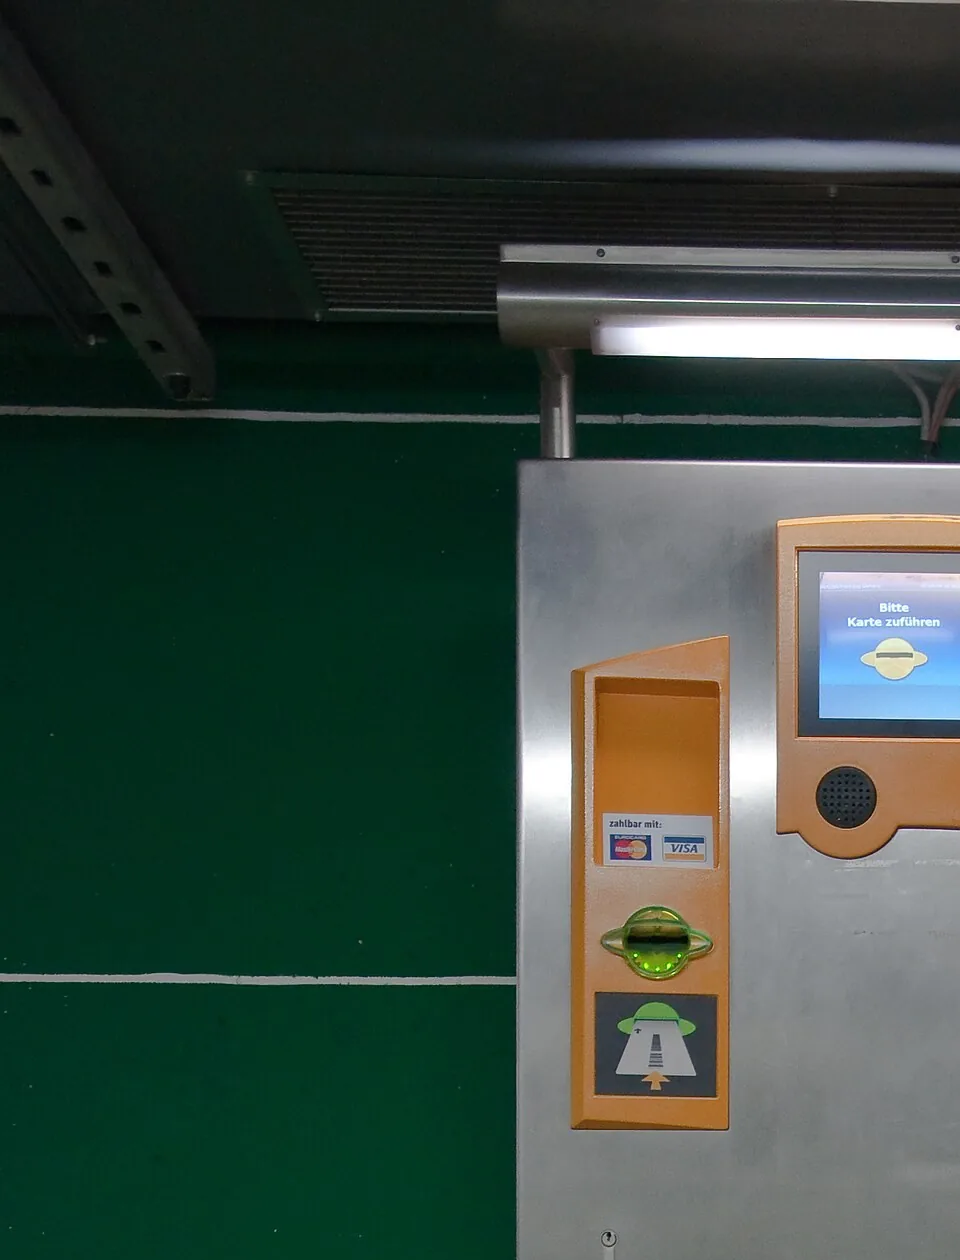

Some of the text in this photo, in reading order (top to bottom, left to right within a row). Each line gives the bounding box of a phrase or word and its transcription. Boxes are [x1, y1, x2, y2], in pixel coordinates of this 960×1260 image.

[879, 602, 910, 613] Bitte
[847, 616, 941, 628] Karte zuführen
[609, 819, 662, 829] zahlbar mit:
[670, 843, 699, 853] VISA
